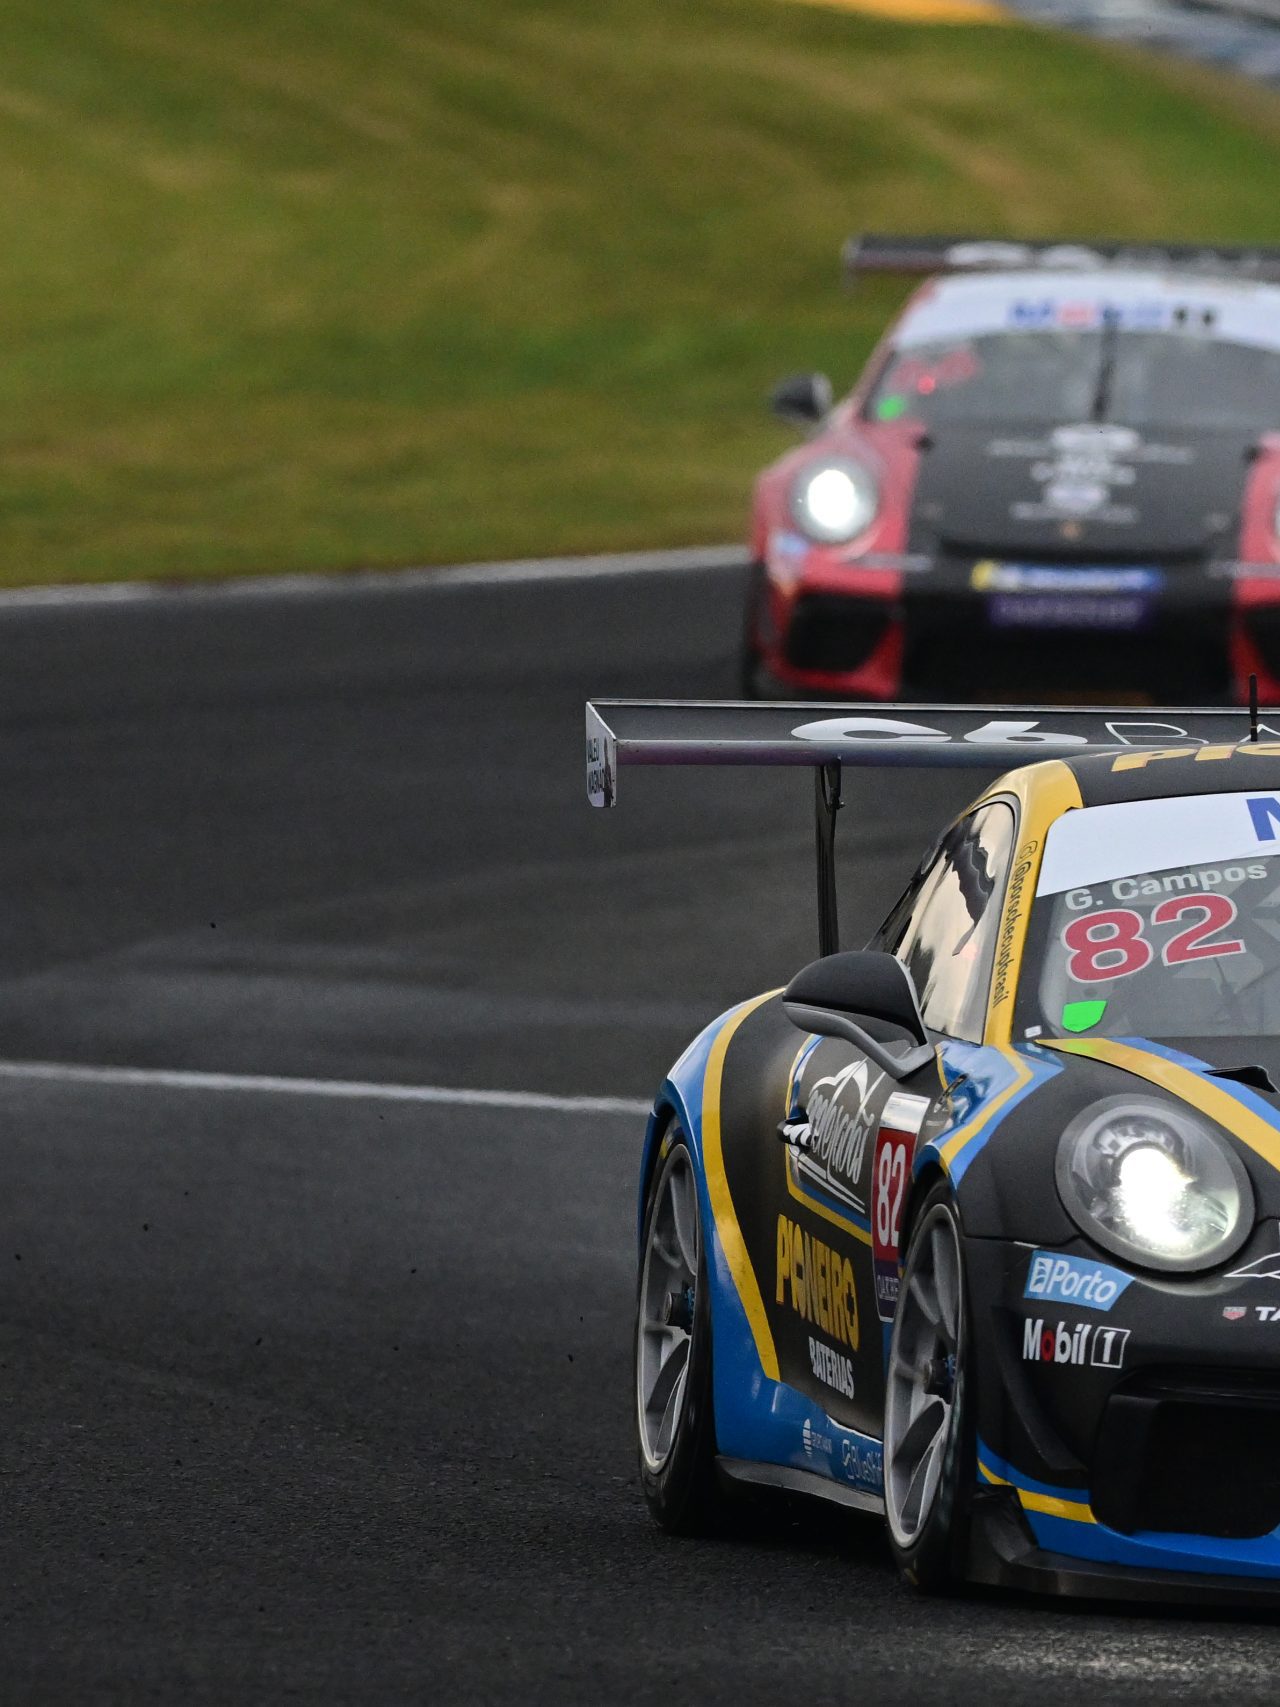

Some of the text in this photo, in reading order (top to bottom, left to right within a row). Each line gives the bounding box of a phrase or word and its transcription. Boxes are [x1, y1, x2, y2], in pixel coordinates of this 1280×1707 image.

[791, 717, 1088, 744] C6
[1065, 862, 1268, 911] G. Campos
[1060, 892, 1247, 984] 82
[876, 1141, 907, 1248] 82
[776, 1213, 860, 1352] PIONEIRO
[1046, 1265, 1117, 1303] Porto
[808, 1336, 855, 1400] BATERIAS
[1023, 1318, 1117, 1365] Mobil 1
